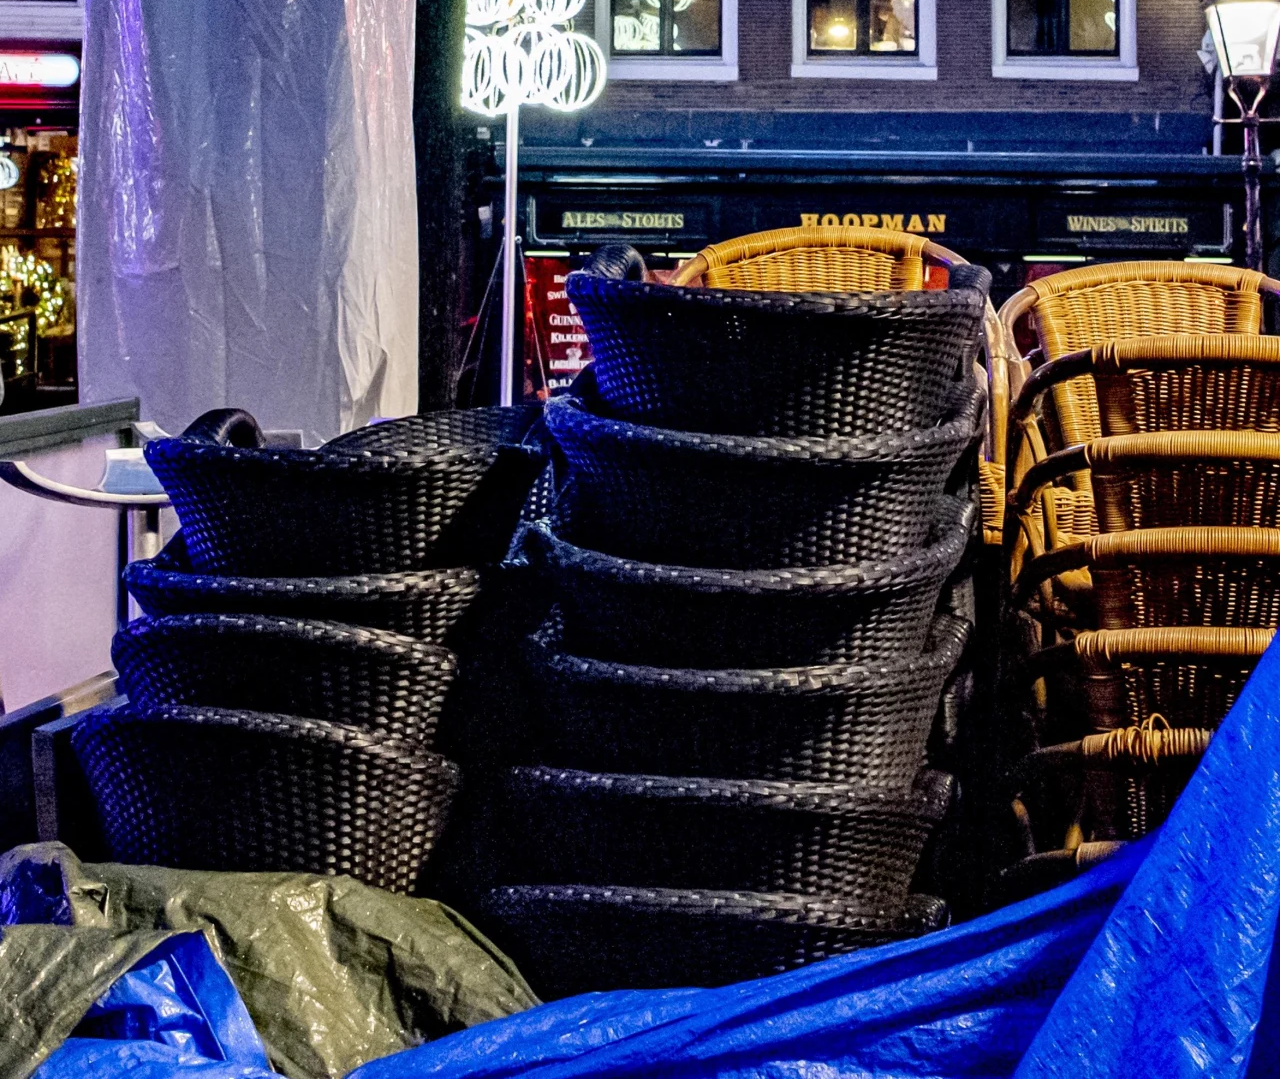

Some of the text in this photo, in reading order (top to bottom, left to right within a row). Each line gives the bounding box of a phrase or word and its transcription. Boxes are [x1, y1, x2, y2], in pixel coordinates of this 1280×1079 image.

[562, 211, 685, 229] ALES STOUTS
[800, 213, 947, 233] HOOPMAN
[1067, 215, 1188, 233] WINES SPIRITS
